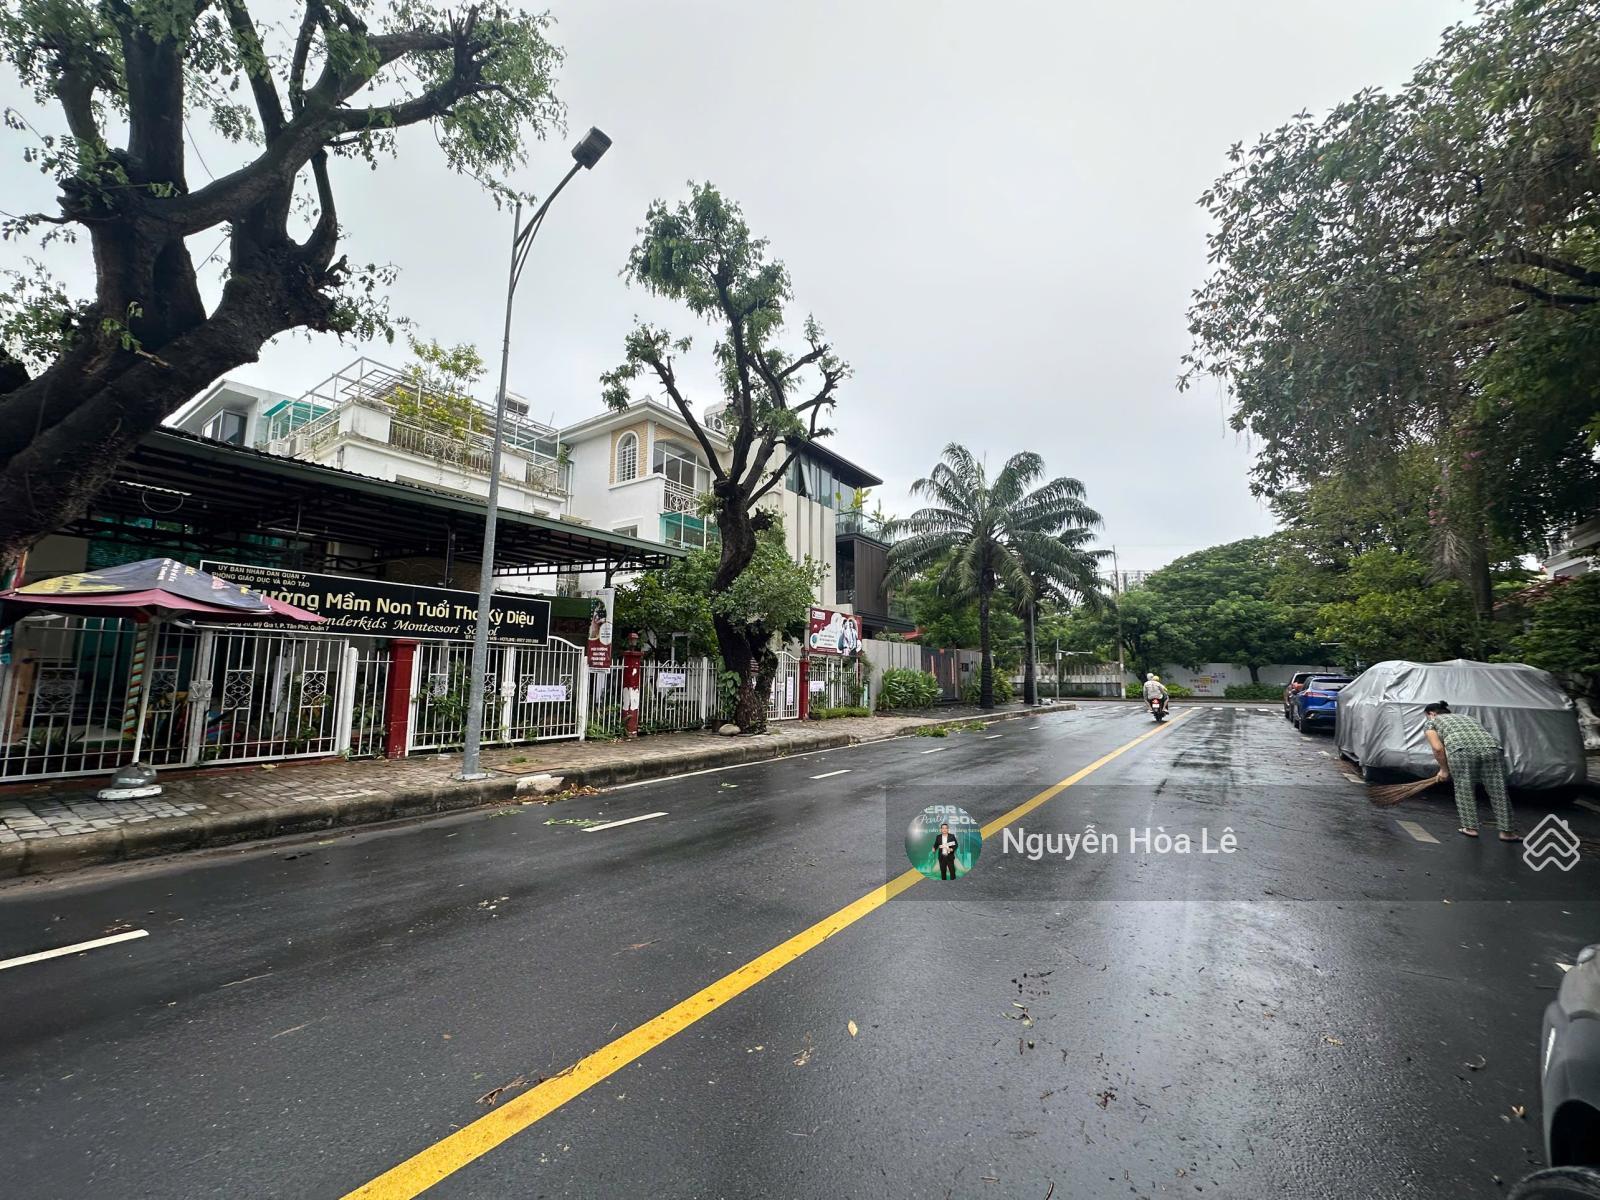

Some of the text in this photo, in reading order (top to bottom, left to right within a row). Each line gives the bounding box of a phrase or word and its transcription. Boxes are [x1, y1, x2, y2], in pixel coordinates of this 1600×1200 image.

[316, 611, 501, 637] nderkids Montessori Scol
[325, 592, 371, 612] Mầm
[376, 597, 412, 615] Non
[417, 600, 450, 619] Tuổi
[507, 611, 535, 629] Diệu
